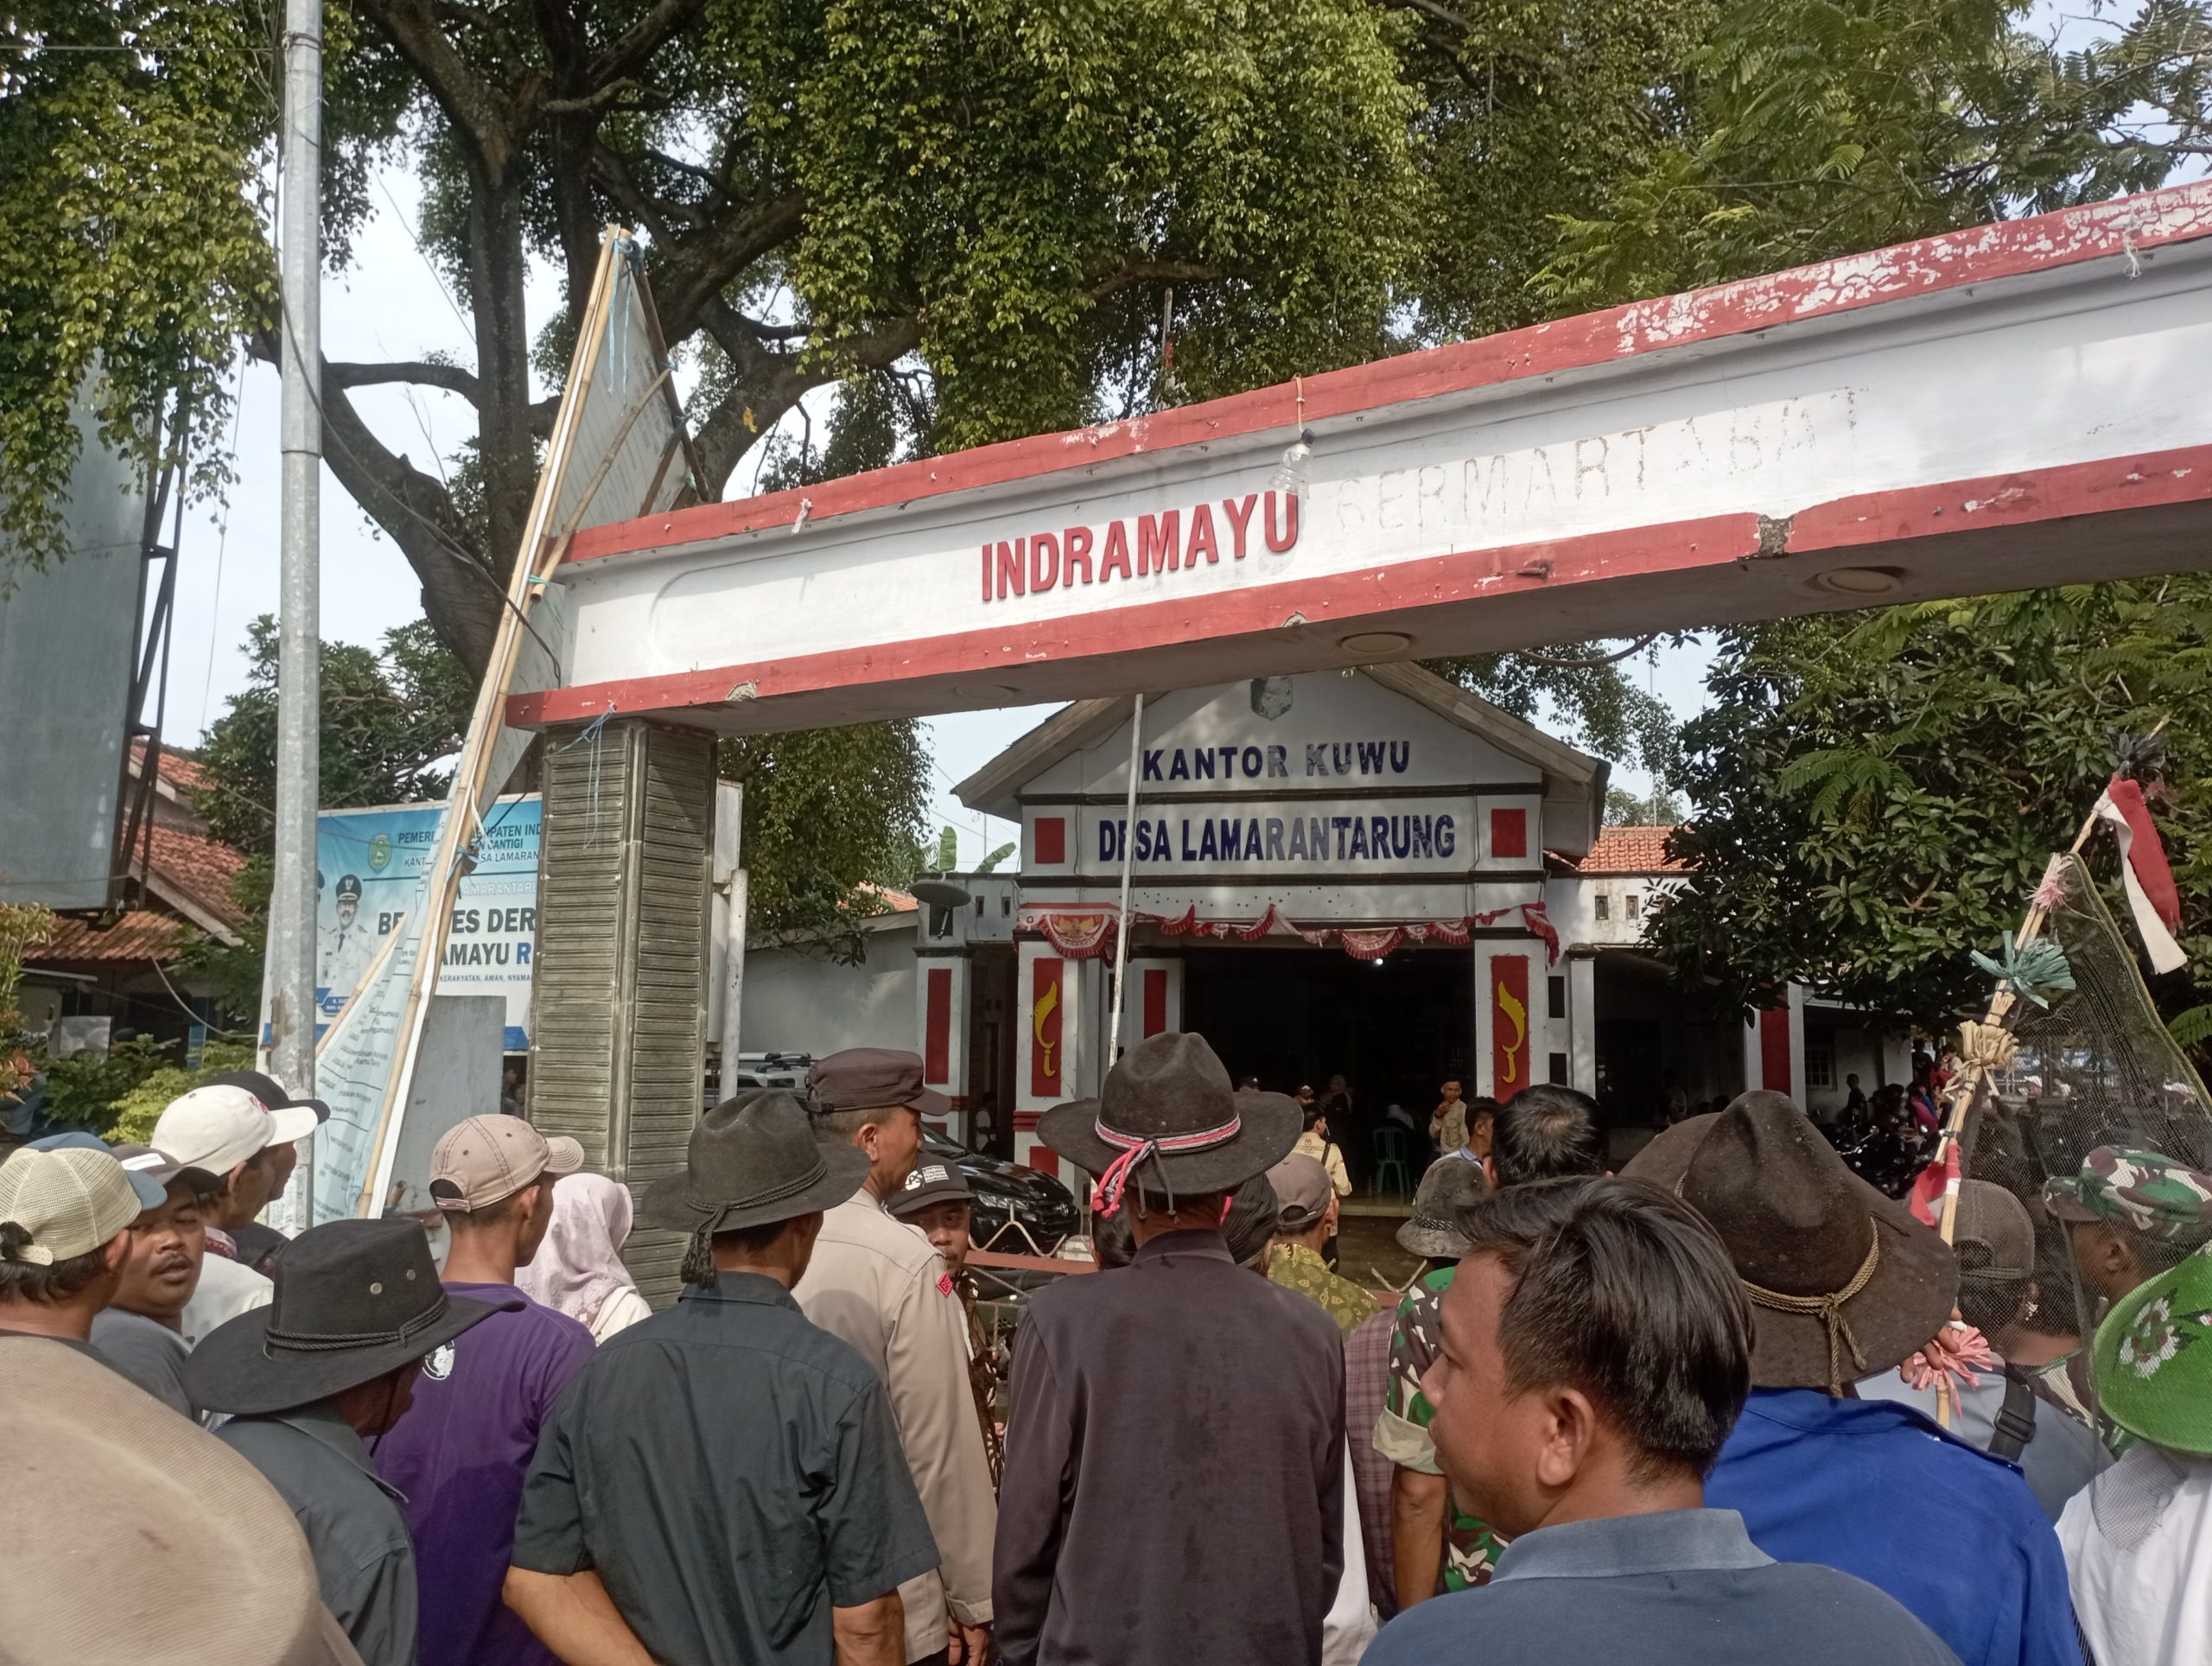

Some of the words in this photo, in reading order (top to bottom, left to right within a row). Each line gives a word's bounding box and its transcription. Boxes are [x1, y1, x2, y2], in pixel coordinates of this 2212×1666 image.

[982, 490, 1299, 601] INDRAMAYU
[1142, 744, 1288, 781] KANTOR
[1306, 741, 1410, 777] KUWU
[1181, 814, 1455, 862] LAMARANTARUNG
